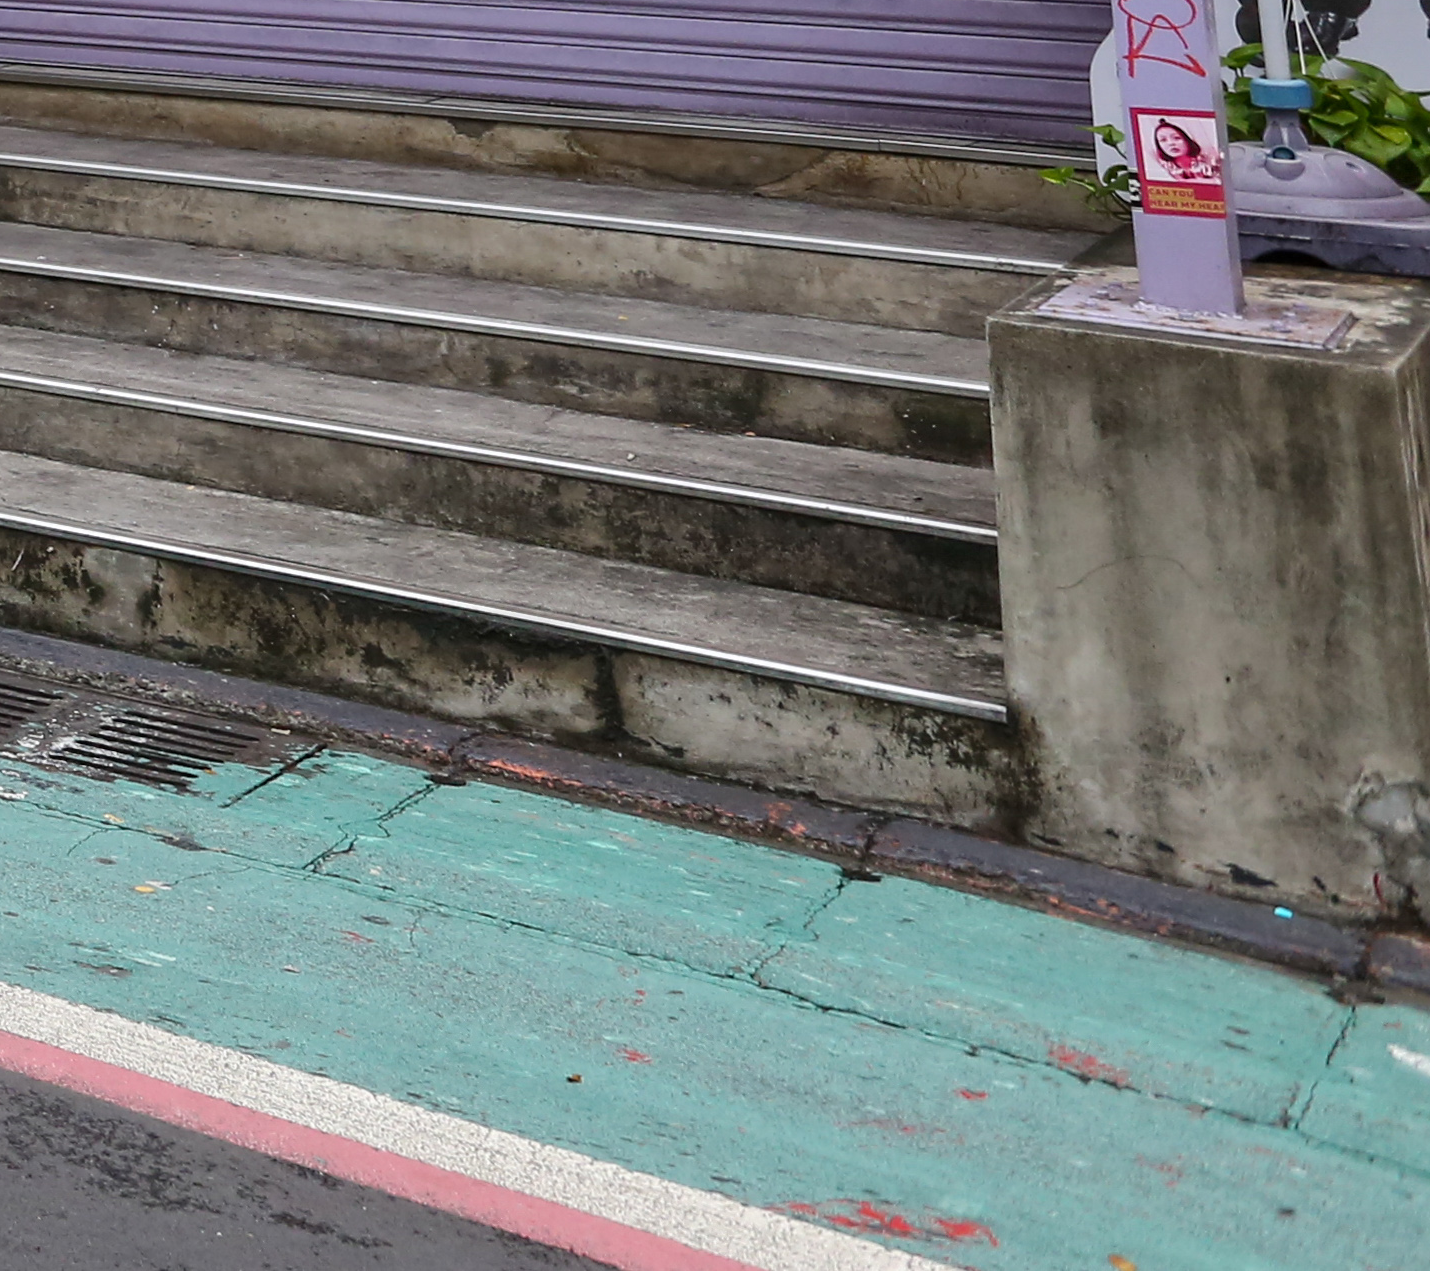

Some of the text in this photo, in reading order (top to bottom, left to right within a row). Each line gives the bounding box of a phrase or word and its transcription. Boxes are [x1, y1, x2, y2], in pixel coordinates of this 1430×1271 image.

[1149, 188, 1194, 197] CAN YOU
[1181, 201, 1194, 209] MY
